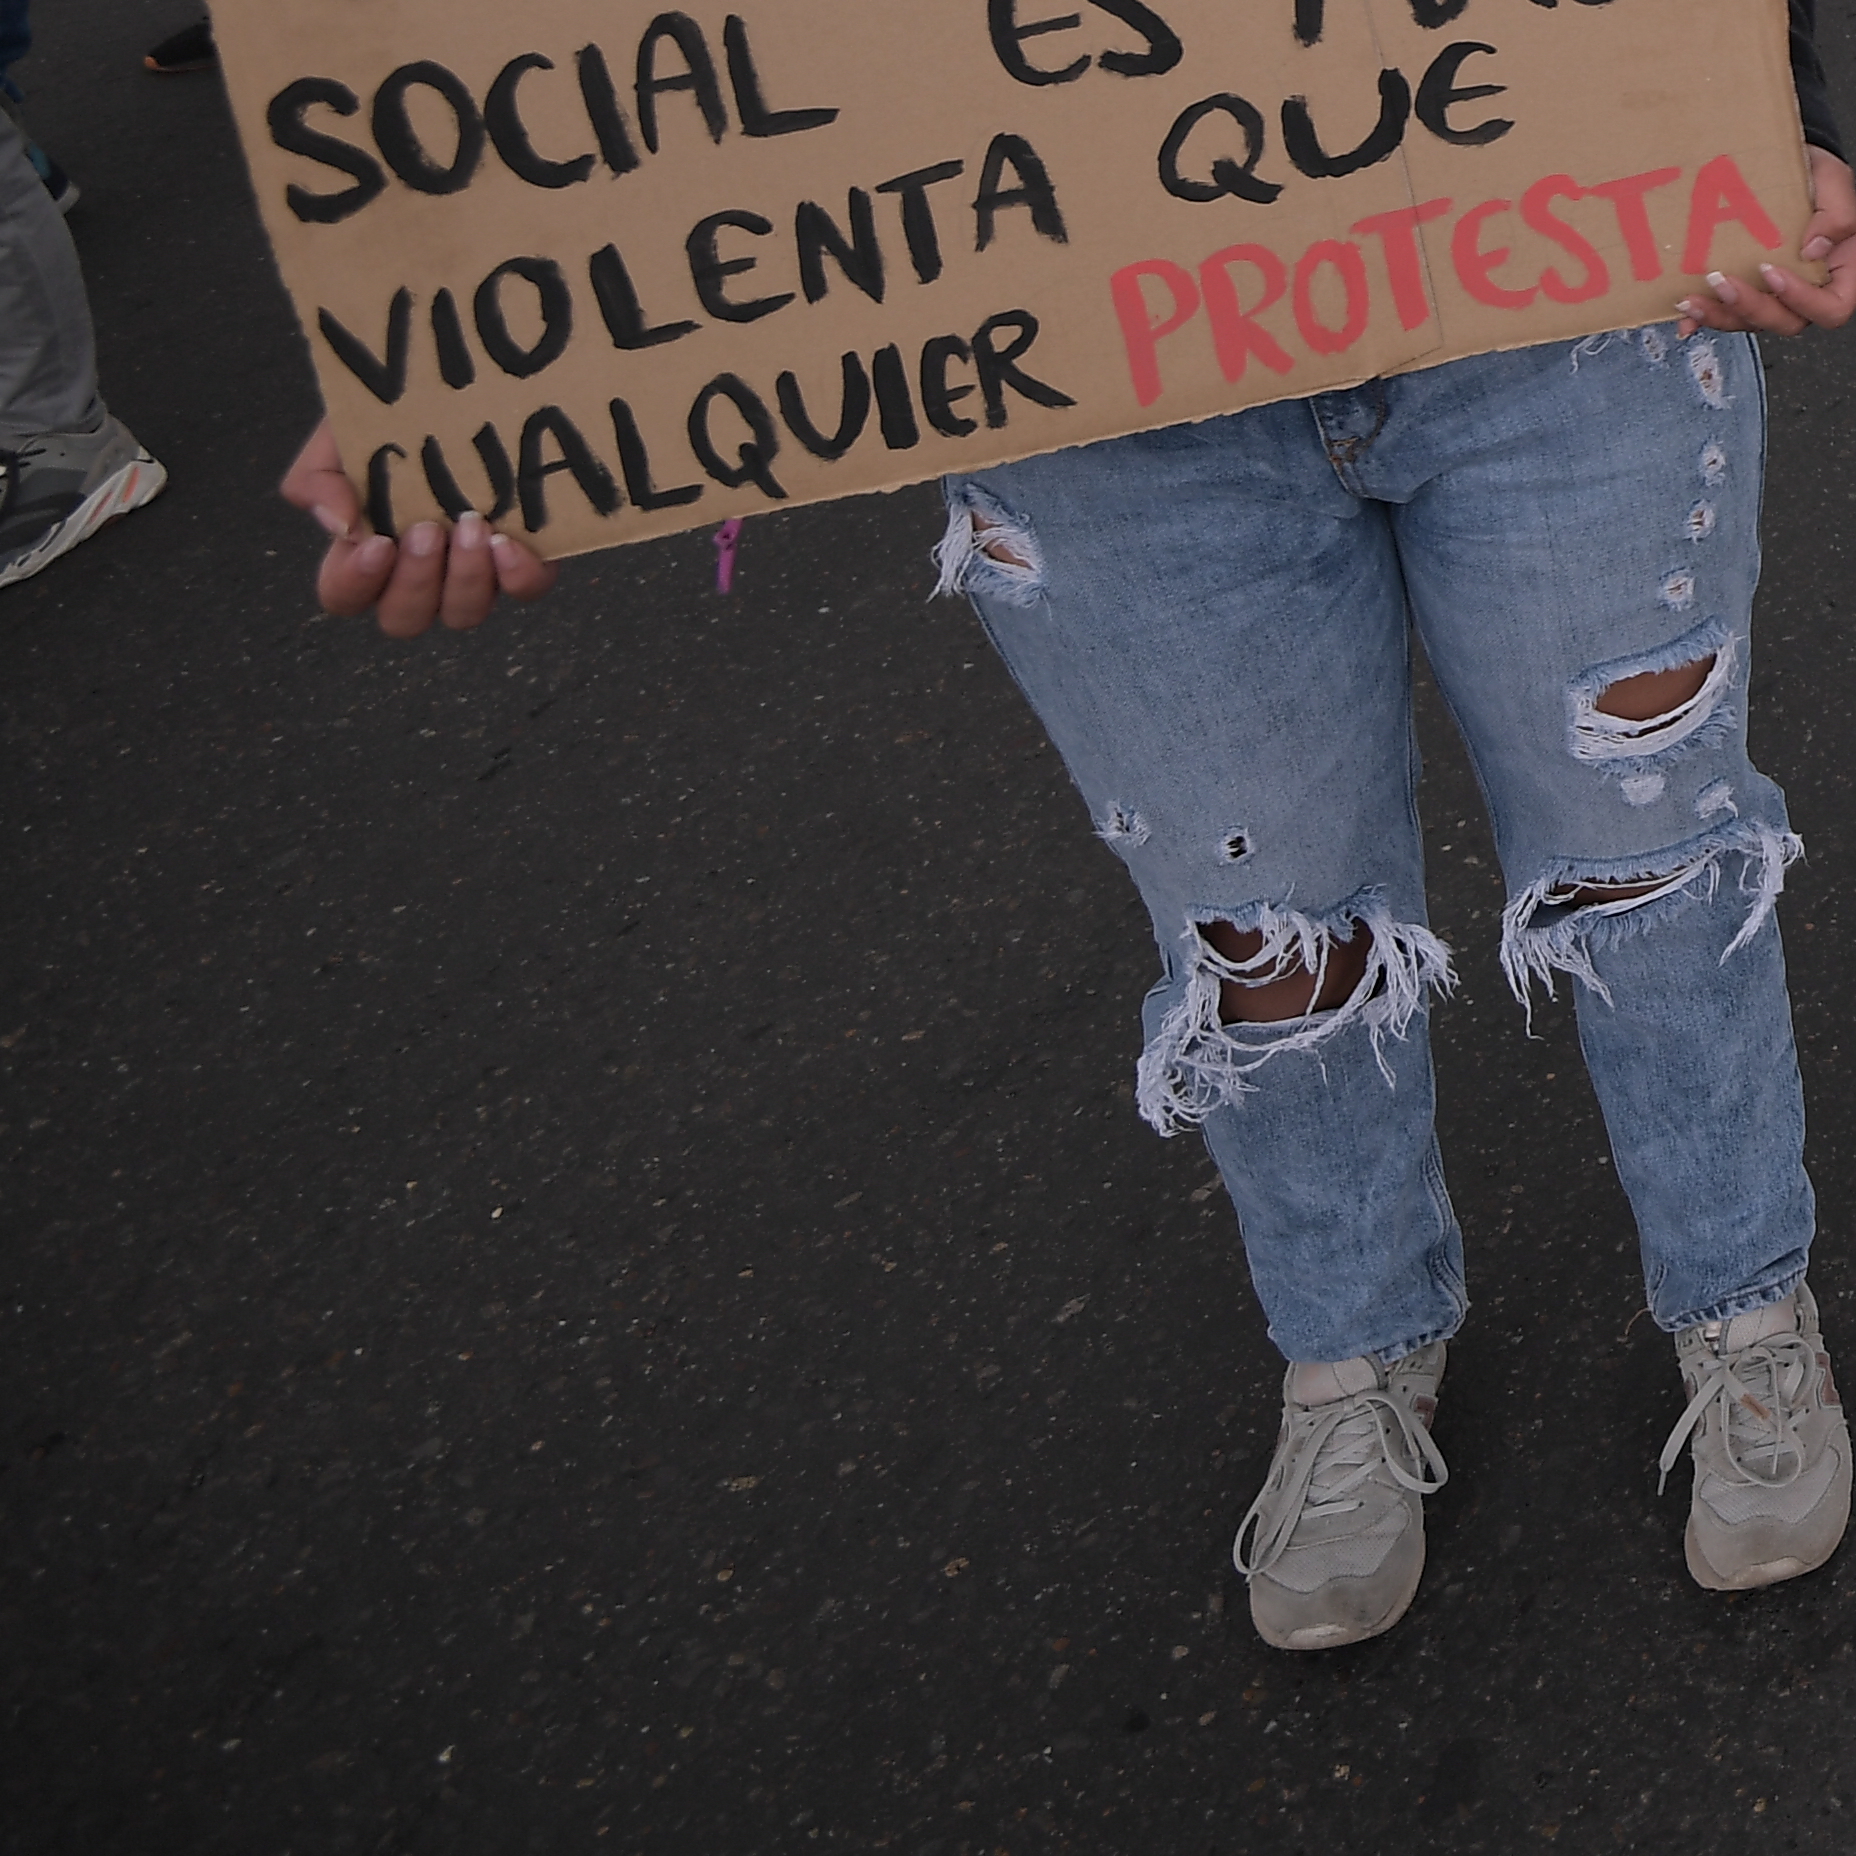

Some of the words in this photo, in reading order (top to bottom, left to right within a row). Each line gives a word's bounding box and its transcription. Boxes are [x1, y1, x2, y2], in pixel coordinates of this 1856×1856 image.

[267, 10, 840, 223] SOCIAL
[317, 133, 1068, 405] VIOLENTA
[1158, 41, 1515, 204] QUE
[366, 310, 1078, 537] CUALQUIER
[1110, 154, 1783, 408] PROTESTA
